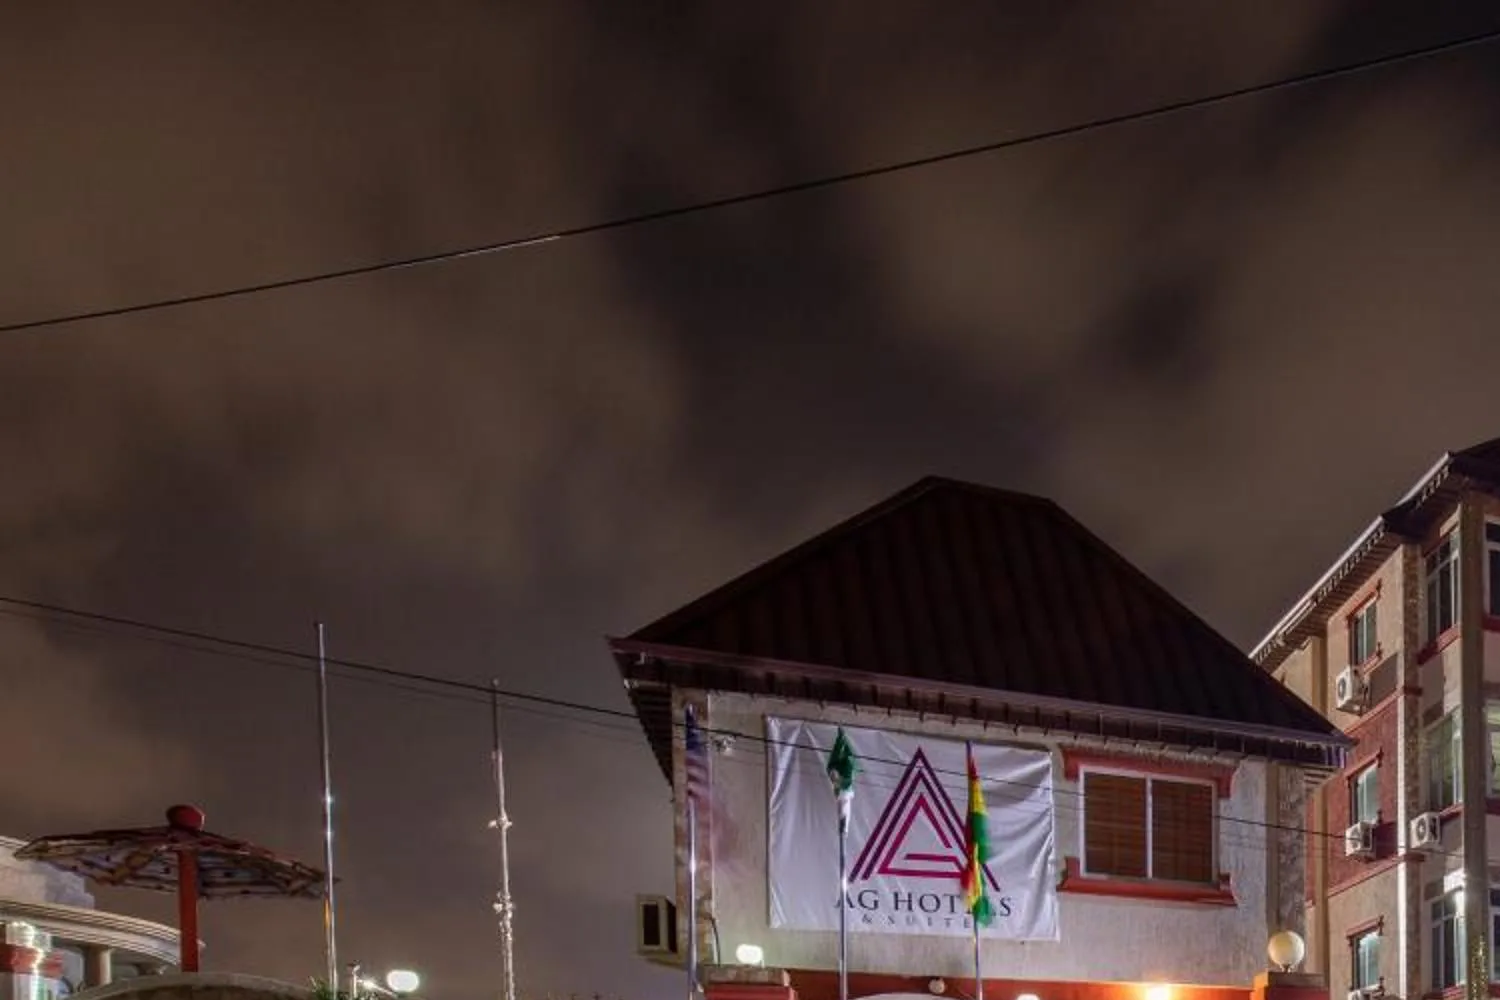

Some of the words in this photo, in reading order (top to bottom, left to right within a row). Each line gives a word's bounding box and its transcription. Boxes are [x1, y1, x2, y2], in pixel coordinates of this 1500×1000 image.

[834, 889, 879, 911] AG
[893, 891, 1012, 917] HOTS
[887, 914, 985, 929] SUITE
